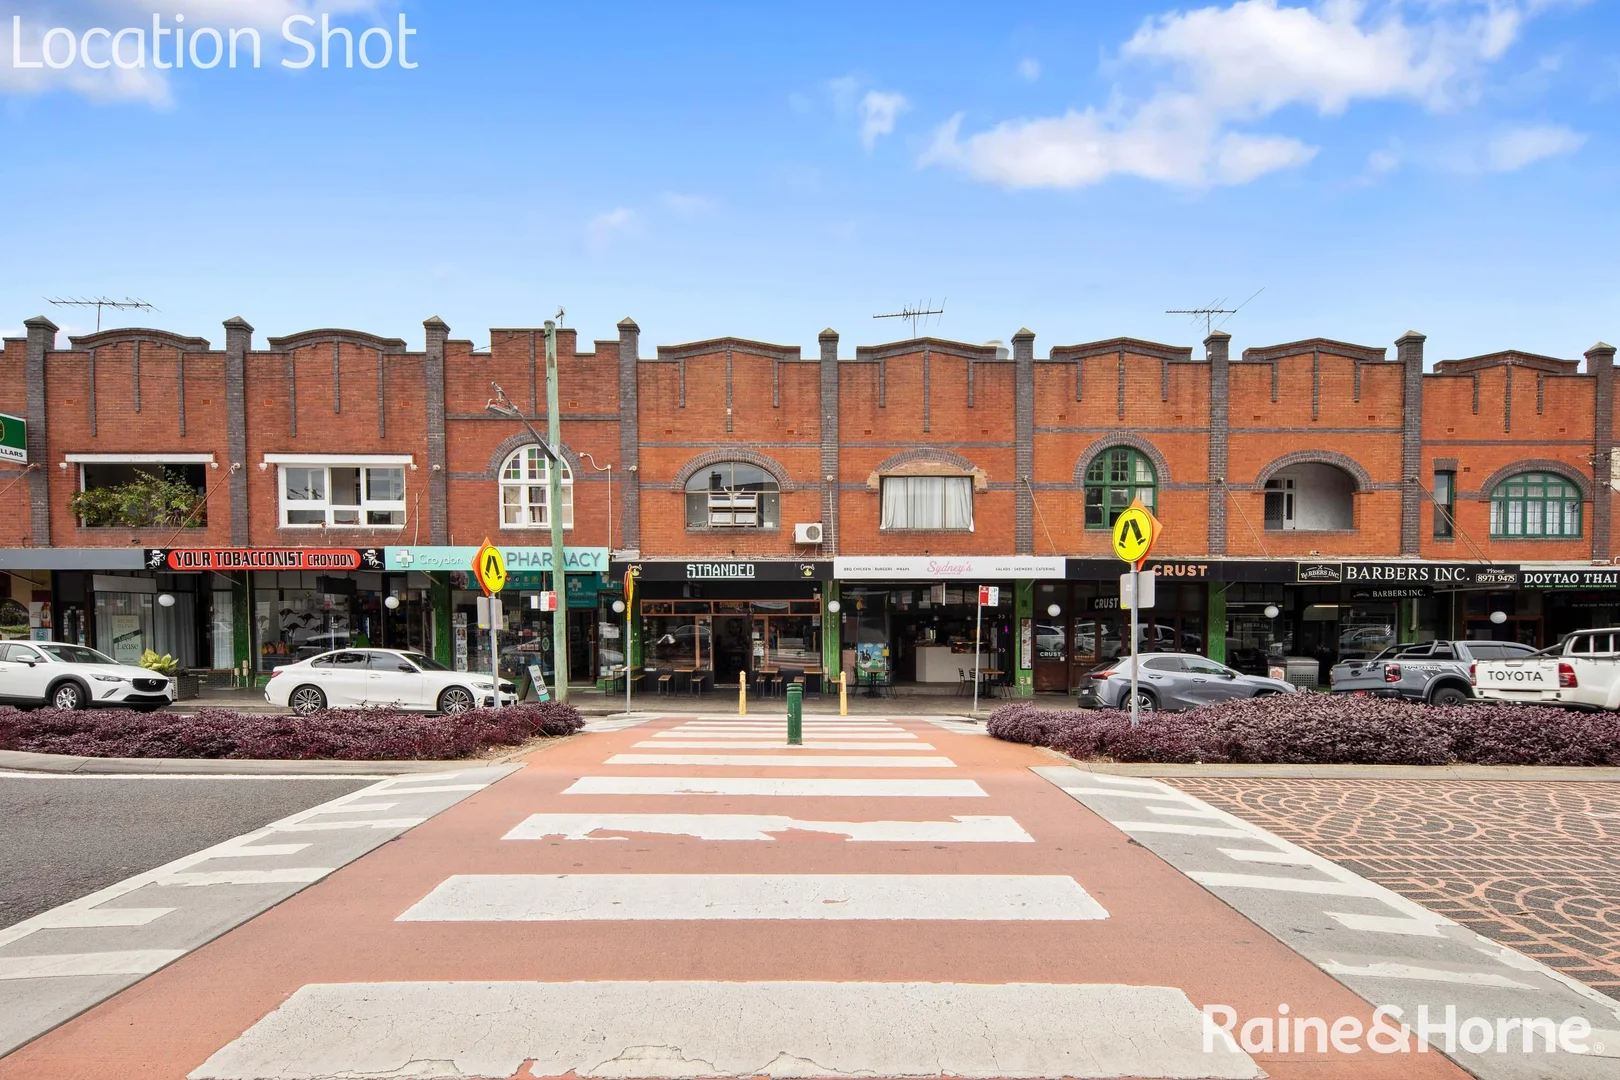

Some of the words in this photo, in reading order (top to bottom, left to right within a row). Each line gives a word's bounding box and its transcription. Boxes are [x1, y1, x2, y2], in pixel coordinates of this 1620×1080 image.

[175, 551, 212, 567] YOUR
[215, 551, 304, 568] TOBACCONIST
[307, 554, 355, 567] CROYDON
[419, 554, 464, 567] Croydon
[686, 563, 755, 578] STRANDED
[926, 560, 974, 575] Sydney's
[1152, 564, 1208, 577] CRUST
[1346, 566, 1429, 581] BARBERS
[1433, 567, 1470, 581] INC.
[1524, 573, 1580, 584] DOYTAO
[1583, 573, 1618, 584] THAI
[1372, 590, 1407, 598] BARBERS
[1408, 589, 1426, 597] INC.
[1094, 598, 1119, 609] CRUST
[1487, 671, 1543, 681] TOYOTA
